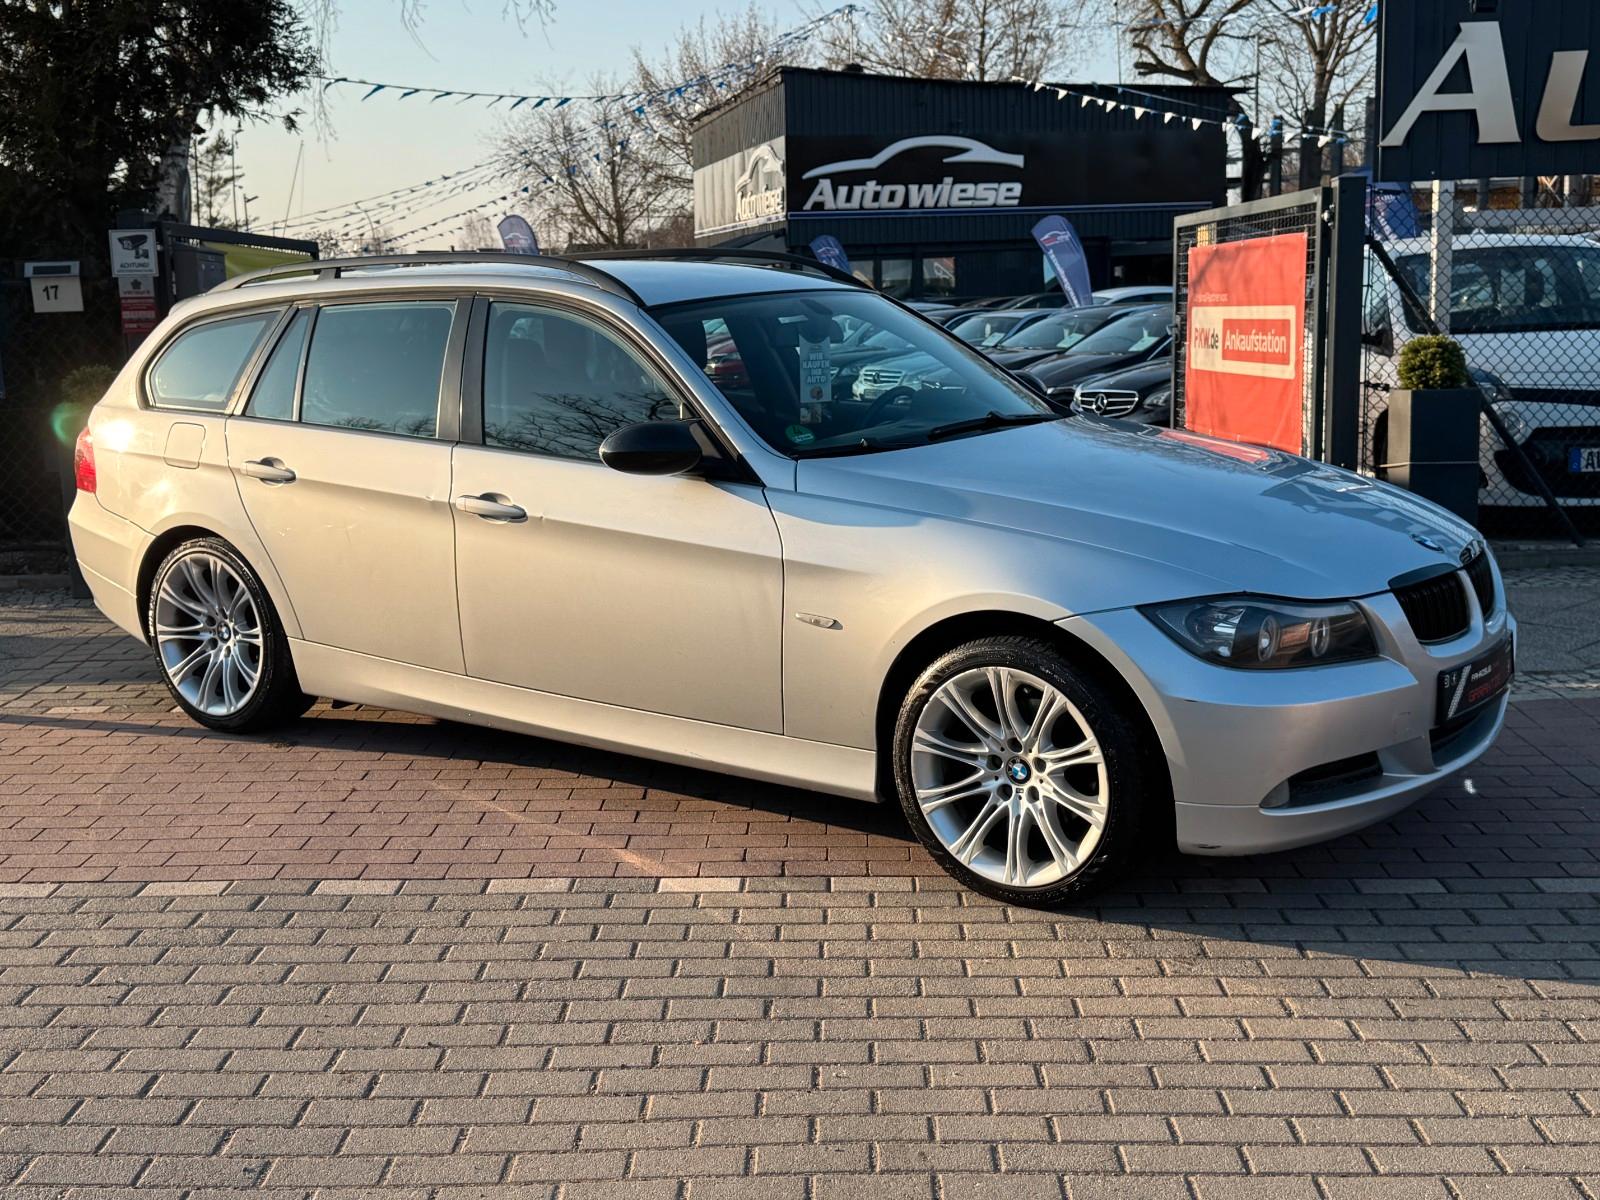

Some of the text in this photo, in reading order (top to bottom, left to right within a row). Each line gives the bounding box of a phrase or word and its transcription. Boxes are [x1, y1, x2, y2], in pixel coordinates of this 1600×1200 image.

[802, 177, 1023, 211] Autowiese
[42, 285, 59, 301] 17
[1224, 328, 1287, 354] Ankaufstation
